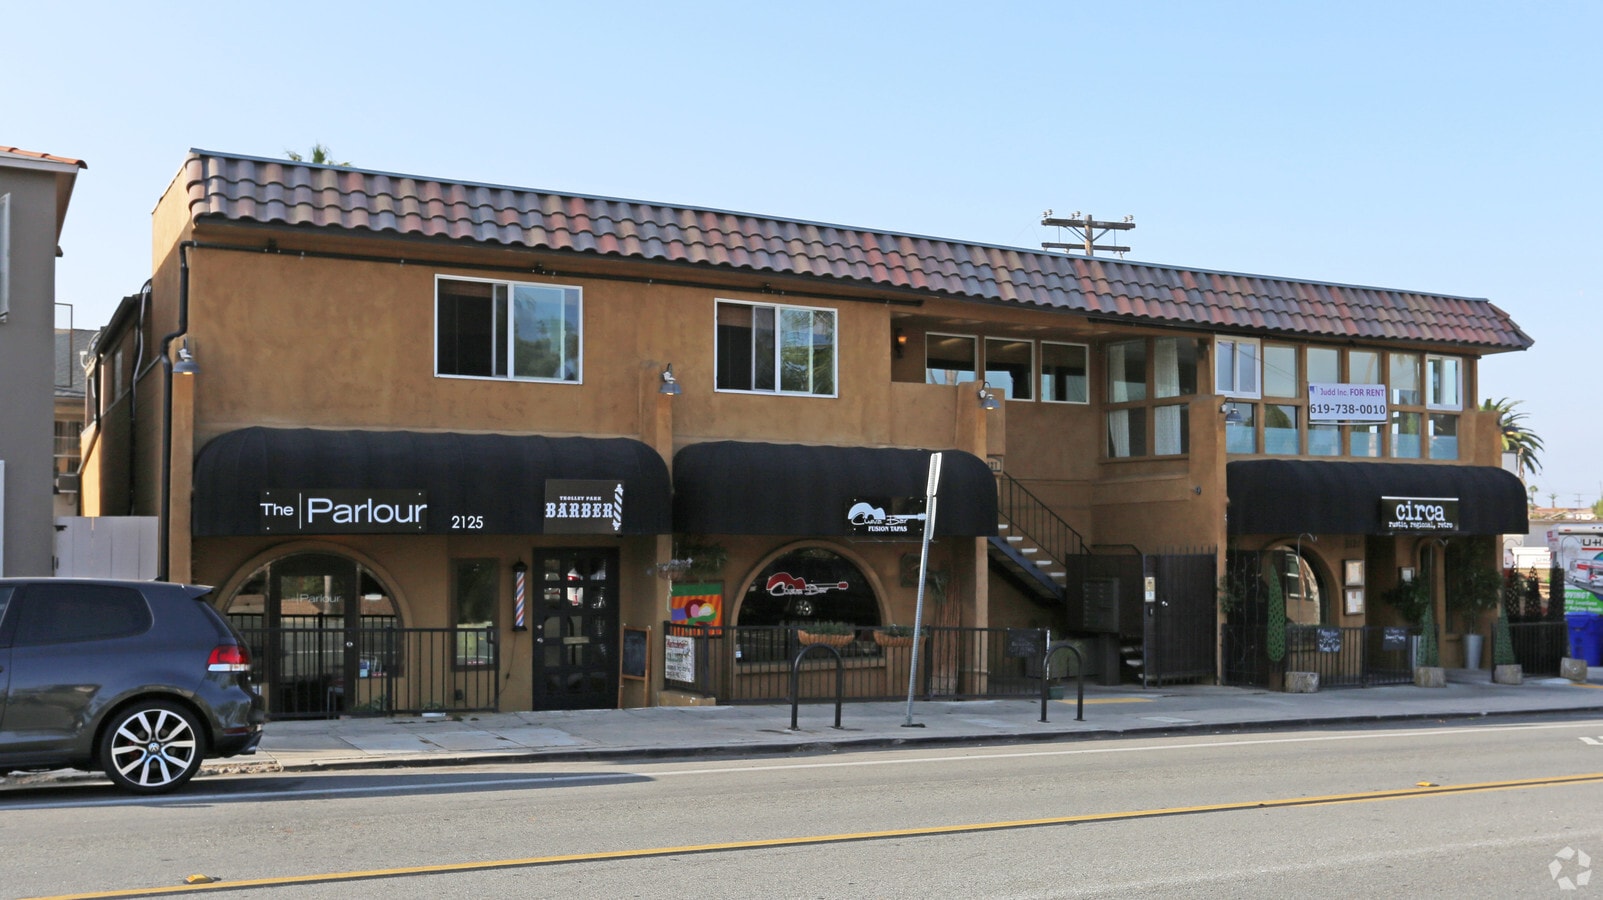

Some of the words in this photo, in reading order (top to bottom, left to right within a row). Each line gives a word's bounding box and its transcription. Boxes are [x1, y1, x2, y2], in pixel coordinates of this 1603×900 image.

[1320, 388, 1336, 396] Judd
[1349, 388, 1364, 396] FOR
[1366, 388, 1385, 397] RENT
[1310, 403, 1386, 414] 619-738-0010
[260, 503, 294, 516] The
[307, 498, 427, 523] Parlour
[545, 502, 613, 518] BARBER
[1396, 501, 1445, 521] circa
[451, 515, 484, 529] 2125
[1437, 521, 1453, 529] retro
[1582, 538, 1603, 546] U-H
[300, 593, 341, 603] Parlour
